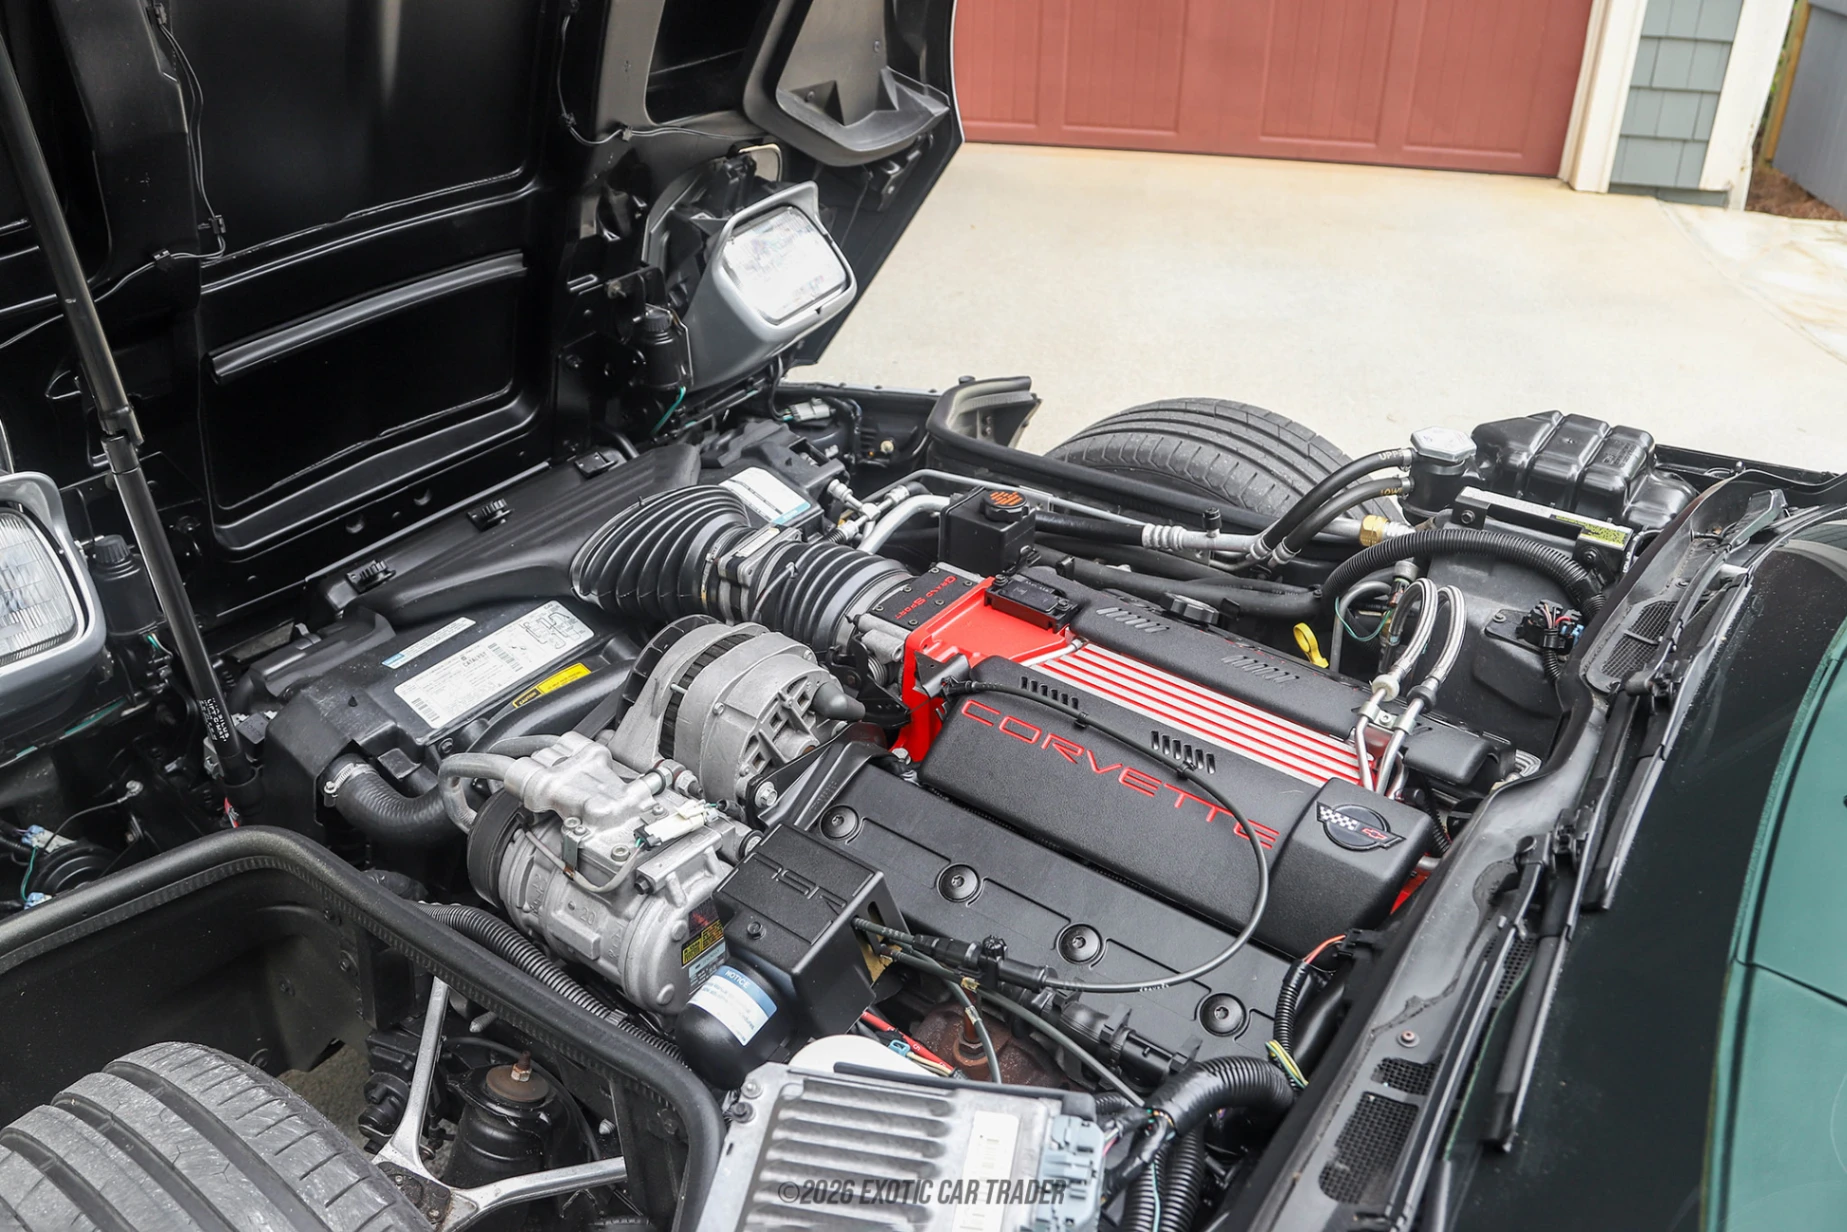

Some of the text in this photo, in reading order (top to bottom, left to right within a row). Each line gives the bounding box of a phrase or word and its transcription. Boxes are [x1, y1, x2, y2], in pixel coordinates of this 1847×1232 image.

[894, 575, 958, 620] GRAND SPORT
[961, 699, 1280, 849] CORVETTE
[724, 969, 749, 989] NOTICE
